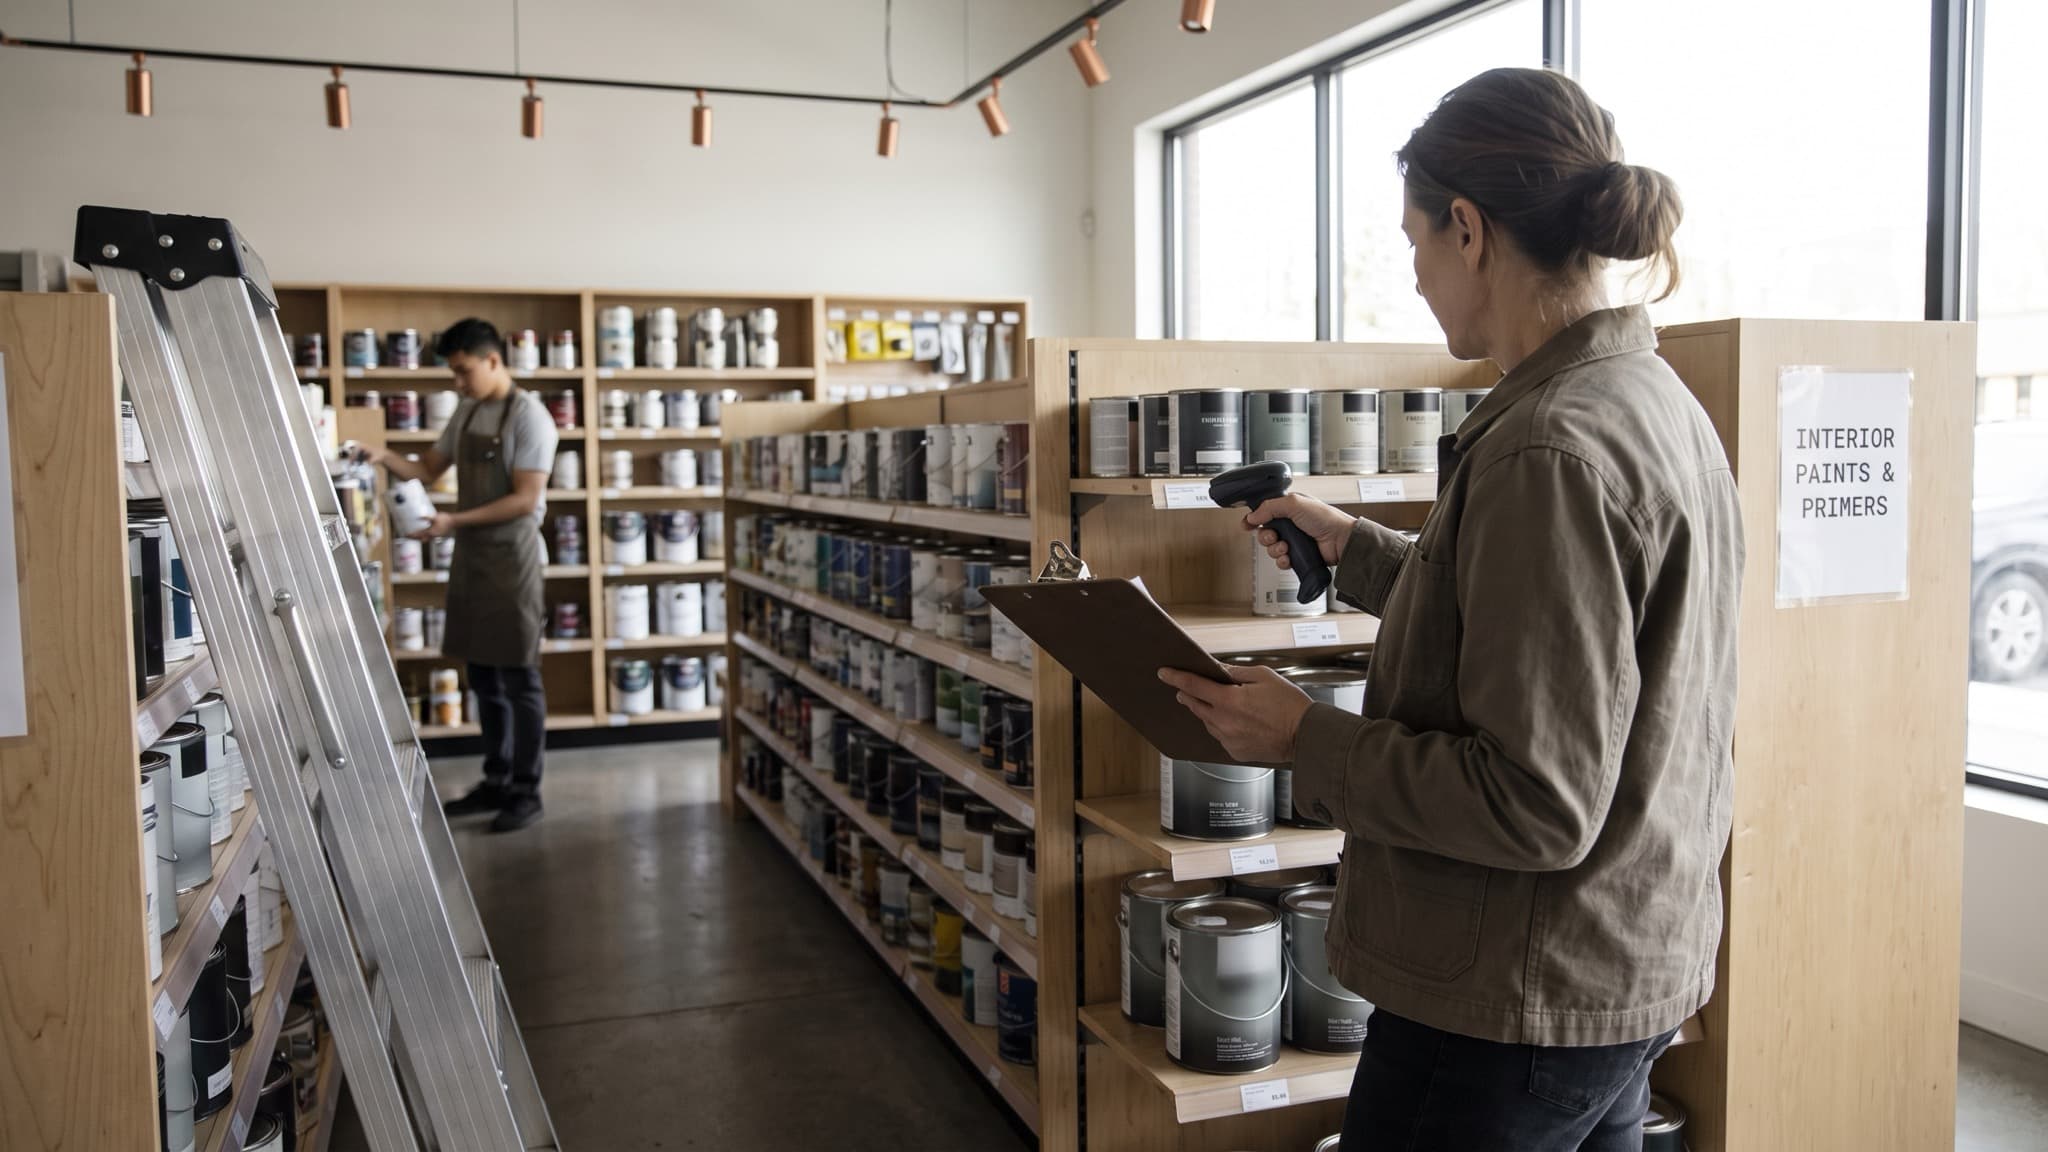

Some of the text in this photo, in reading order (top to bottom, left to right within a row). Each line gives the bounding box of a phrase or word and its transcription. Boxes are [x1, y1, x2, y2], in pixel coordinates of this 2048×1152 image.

[1796, 428, 1895, 449] INTERIOR
[1796, 462, 1895, 484] PAINTS &
[1802, 495, 1888, 518] PRIMERS
